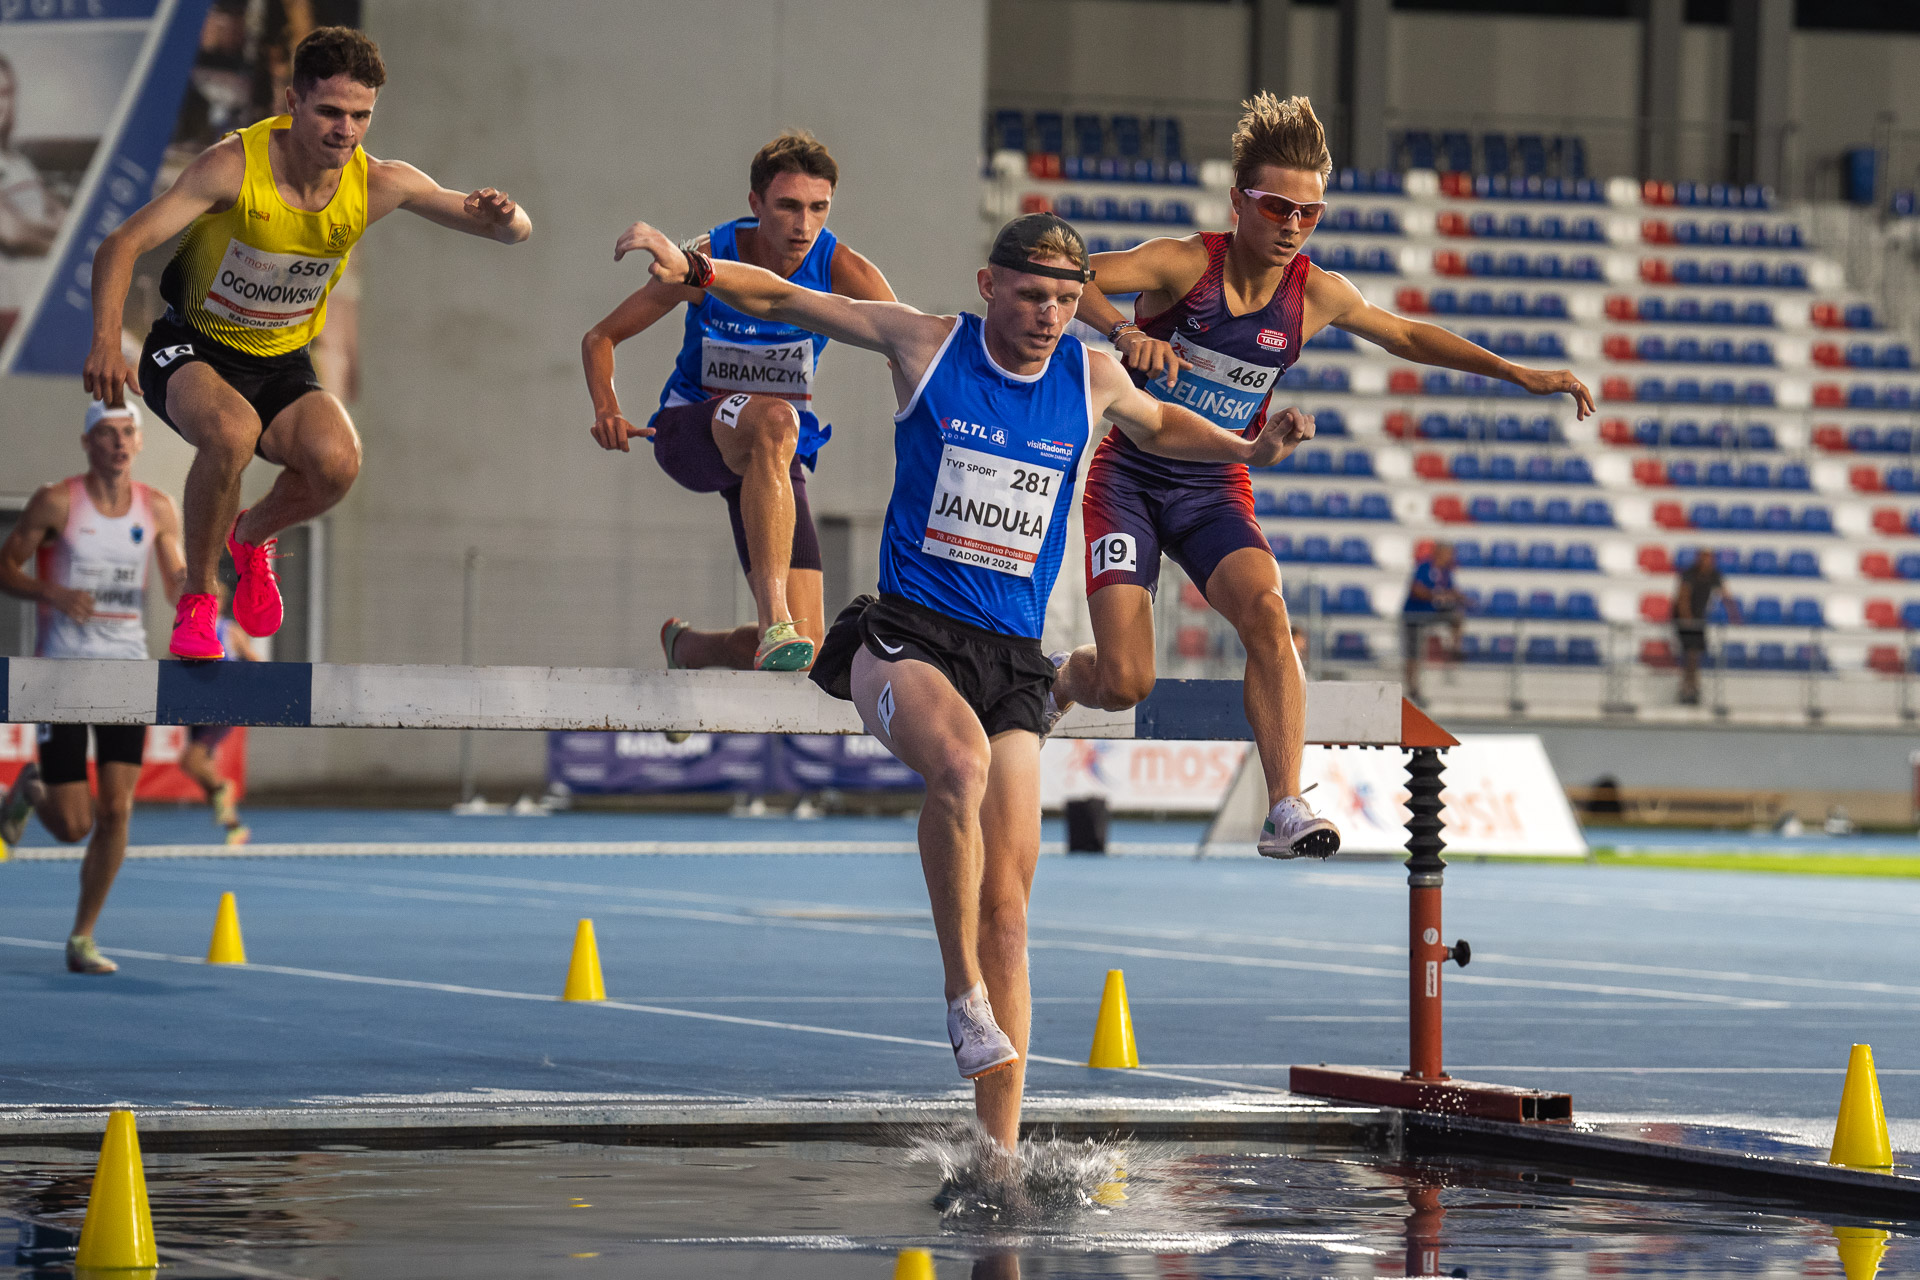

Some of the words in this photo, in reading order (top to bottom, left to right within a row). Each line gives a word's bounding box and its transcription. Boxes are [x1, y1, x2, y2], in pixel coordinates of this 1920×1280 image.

[244, 256, 277, 272] mosir
[288, 260, 330, 277] 650
[221, 270, 322, 305] OGONOWSKI
[228, 312, 266, 327] RADOM
[266, 319, 290, 327] 2024
[1261, 335, 1285, 347] TALEX
[764, 346, 805, 361] 274
[706, 361, 808, 385] ABRAMCZYK
[1226, 366, 1268, 388] 468
[950, 418, 988, 440] RLTL
[1026, 440, 1073, 457] visitRadom.pl
[946, 458, 965, 470] TVP
[966, 463, 998, 478] SPORT
[1009, 468, 1051, 497] 281
[935, 492, 1043, 539] JANDUŁA
[936, 532, 946, 542] 78.
[946, 535, 963, 546] PZLA
[963, 539, 1004, 555] Mistrzostwa
[1004, 548, 1025, 560] Polski
[948, 548, 990, 566] RADOM
[991, 558, 1019, 572] 2024
